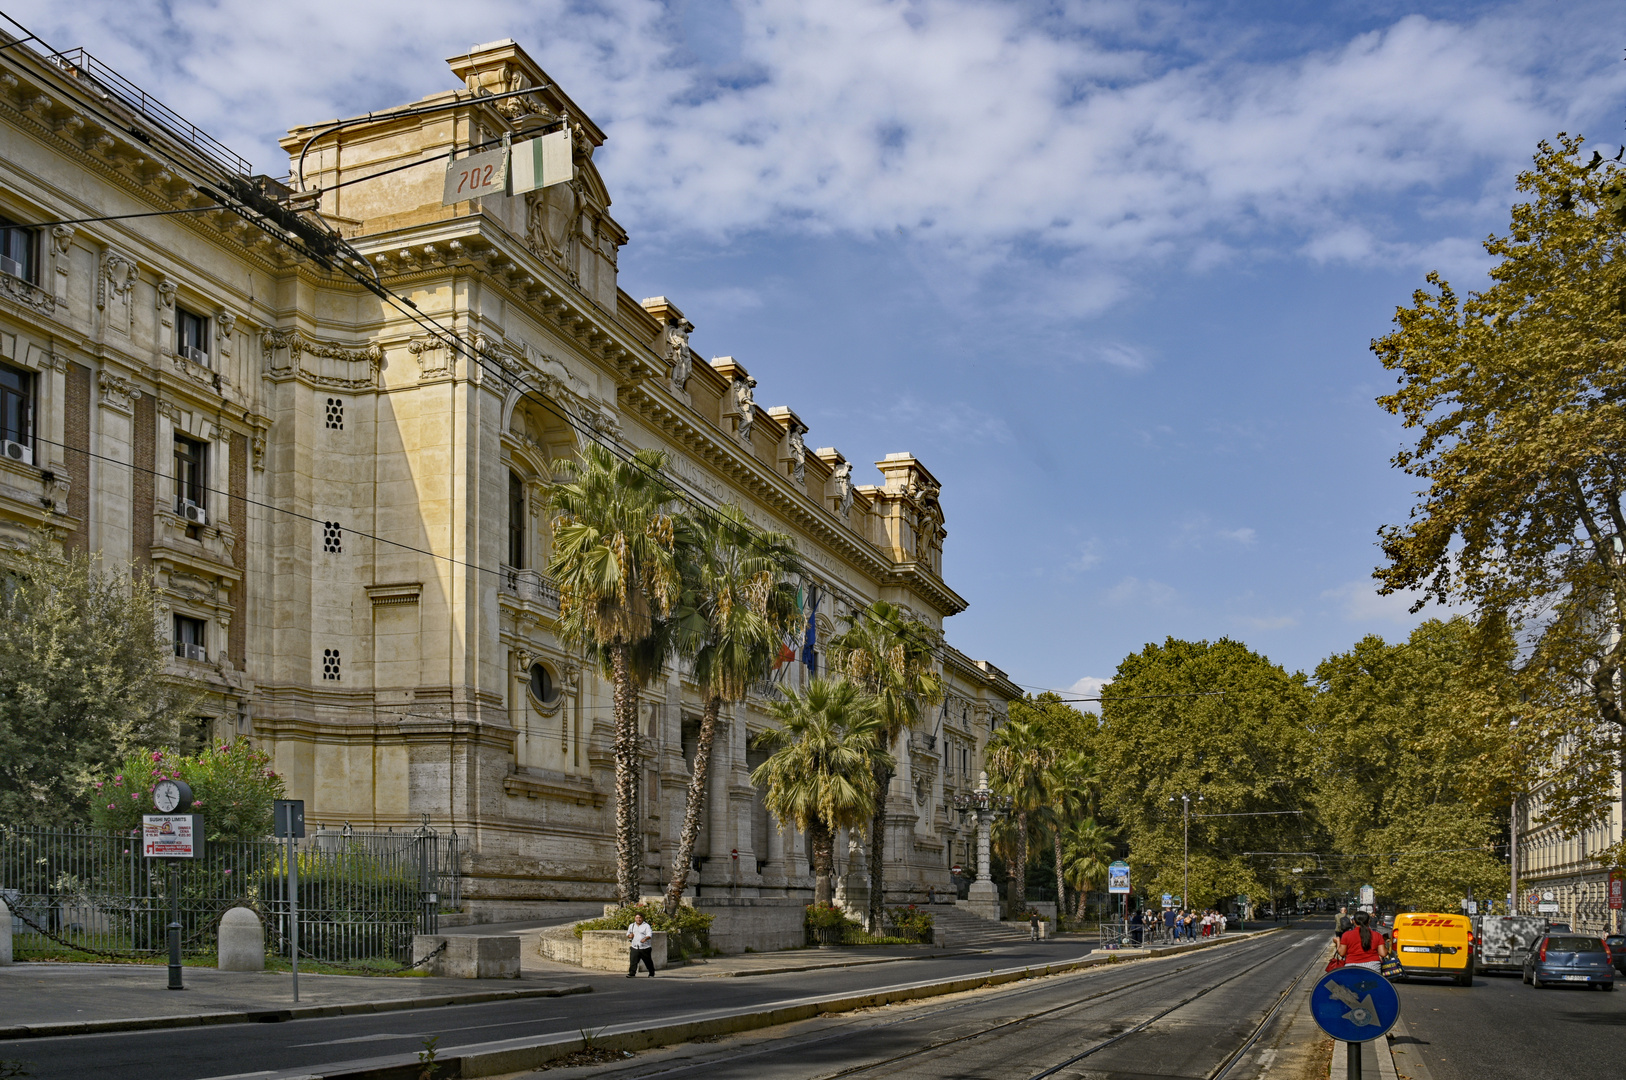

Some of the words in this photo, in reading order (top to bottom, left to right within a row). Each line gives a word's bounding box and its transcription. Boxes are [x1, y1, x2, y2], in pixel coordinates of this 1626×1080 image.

[457, 164, 493, 194] 702
[668, 450, 724, 499] MINISTERO
[1411, 918, 1455, 927] DHL
